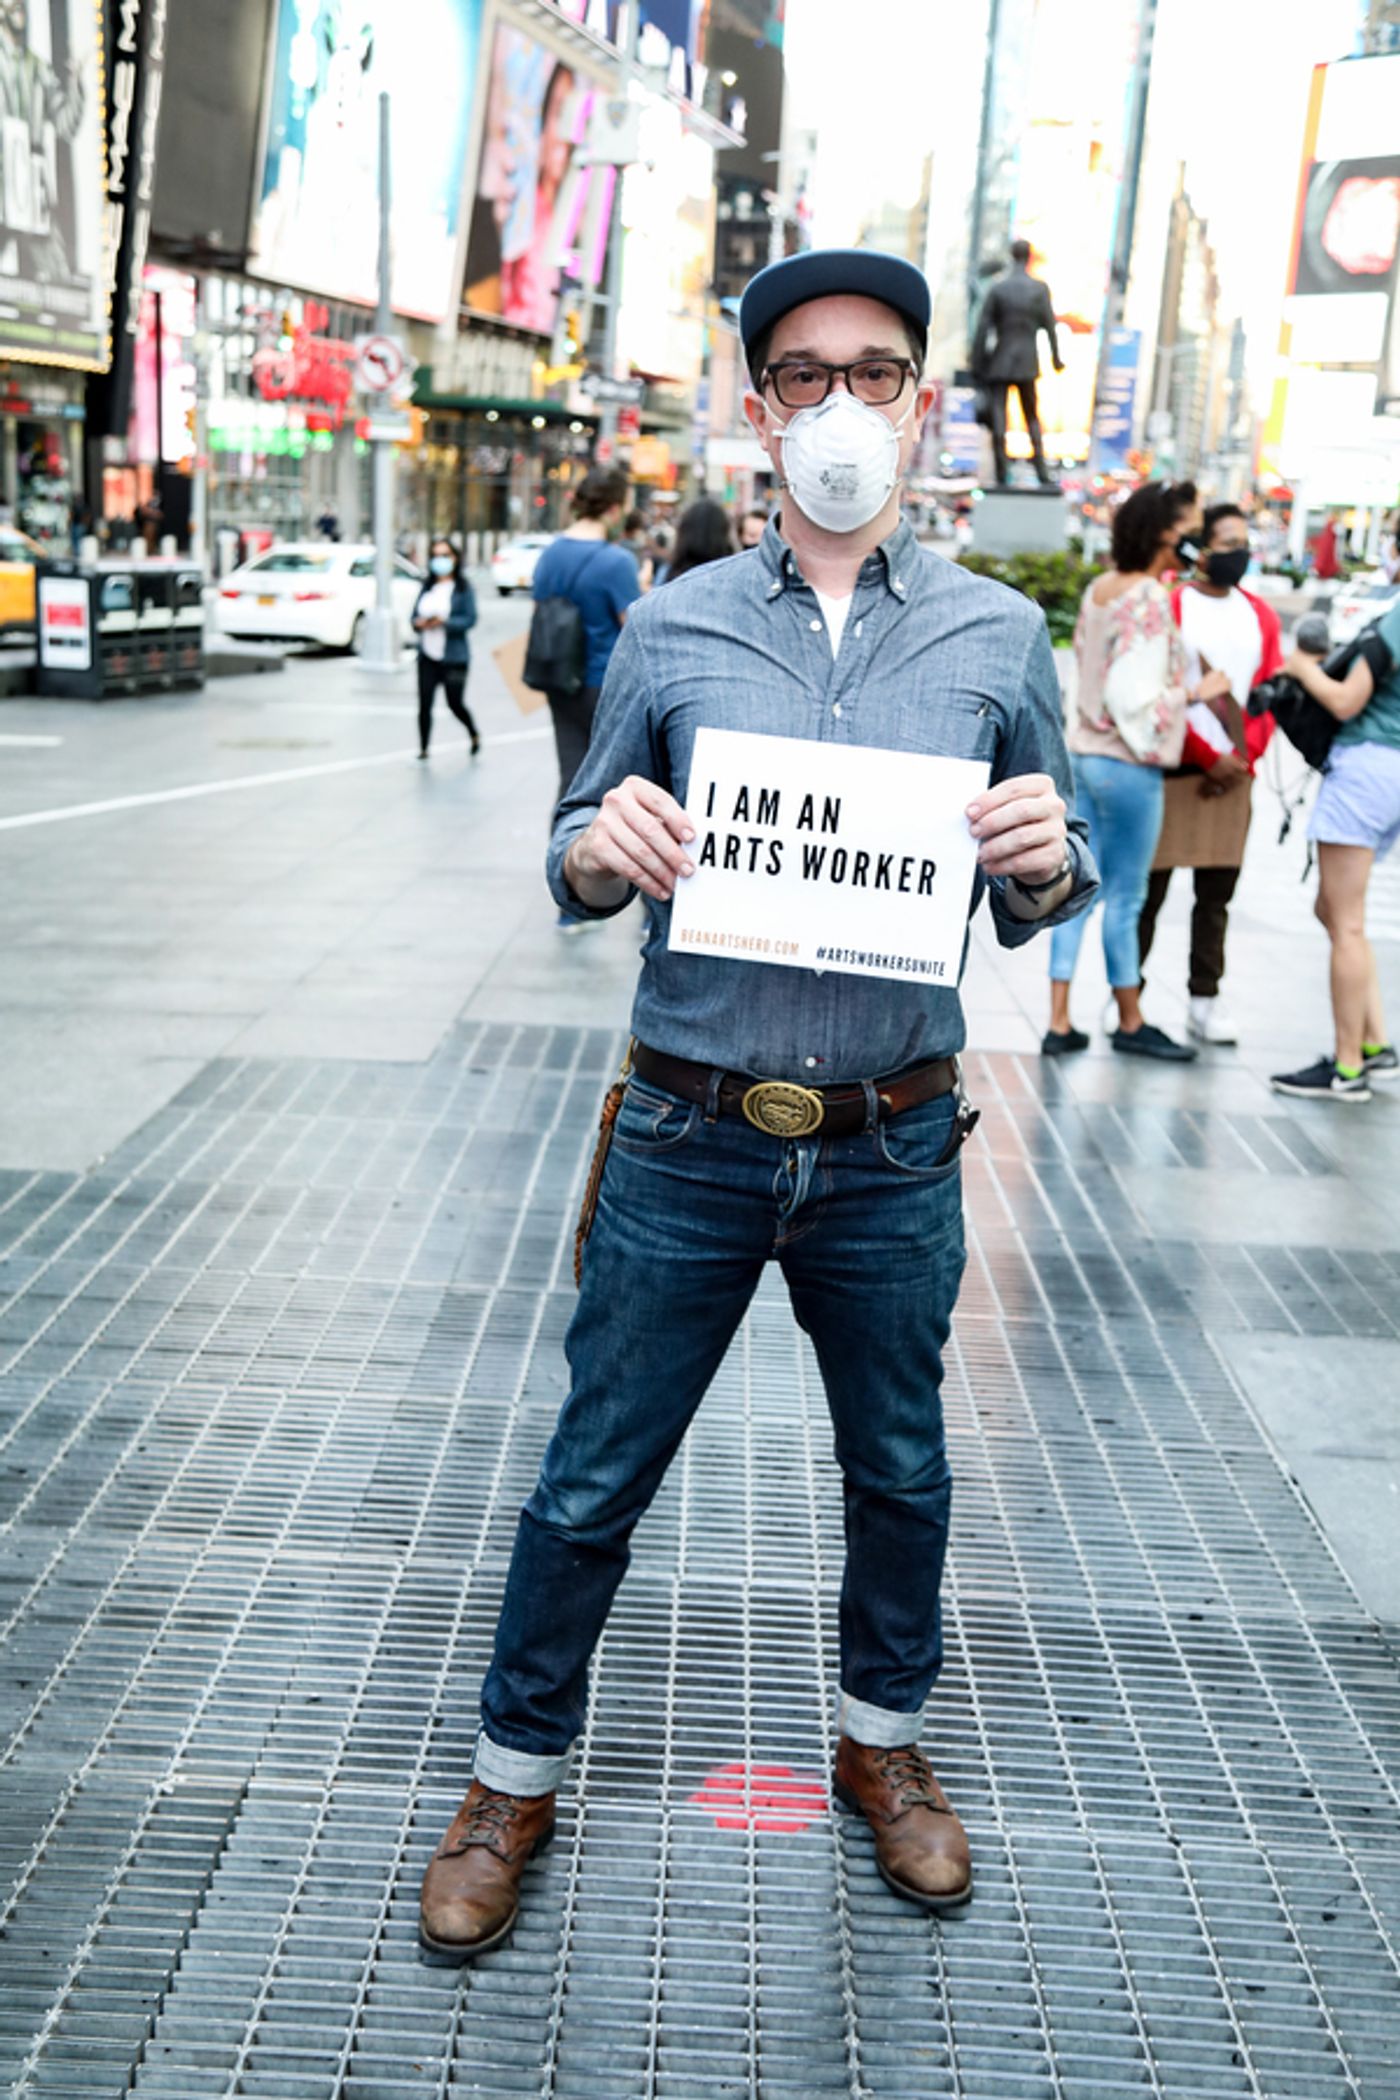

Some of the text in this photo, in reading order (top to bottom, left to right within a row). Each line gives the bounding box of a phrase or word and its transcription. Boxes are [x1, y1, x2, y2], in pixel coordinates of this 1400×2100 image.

[706, 781, 841, 834] I AM AN
[699, 831, 936, 896] ARTS WORKER
[681, 928, 946, 977] BEANARTSHERO.COM #ARTSWORKERSUNITE
